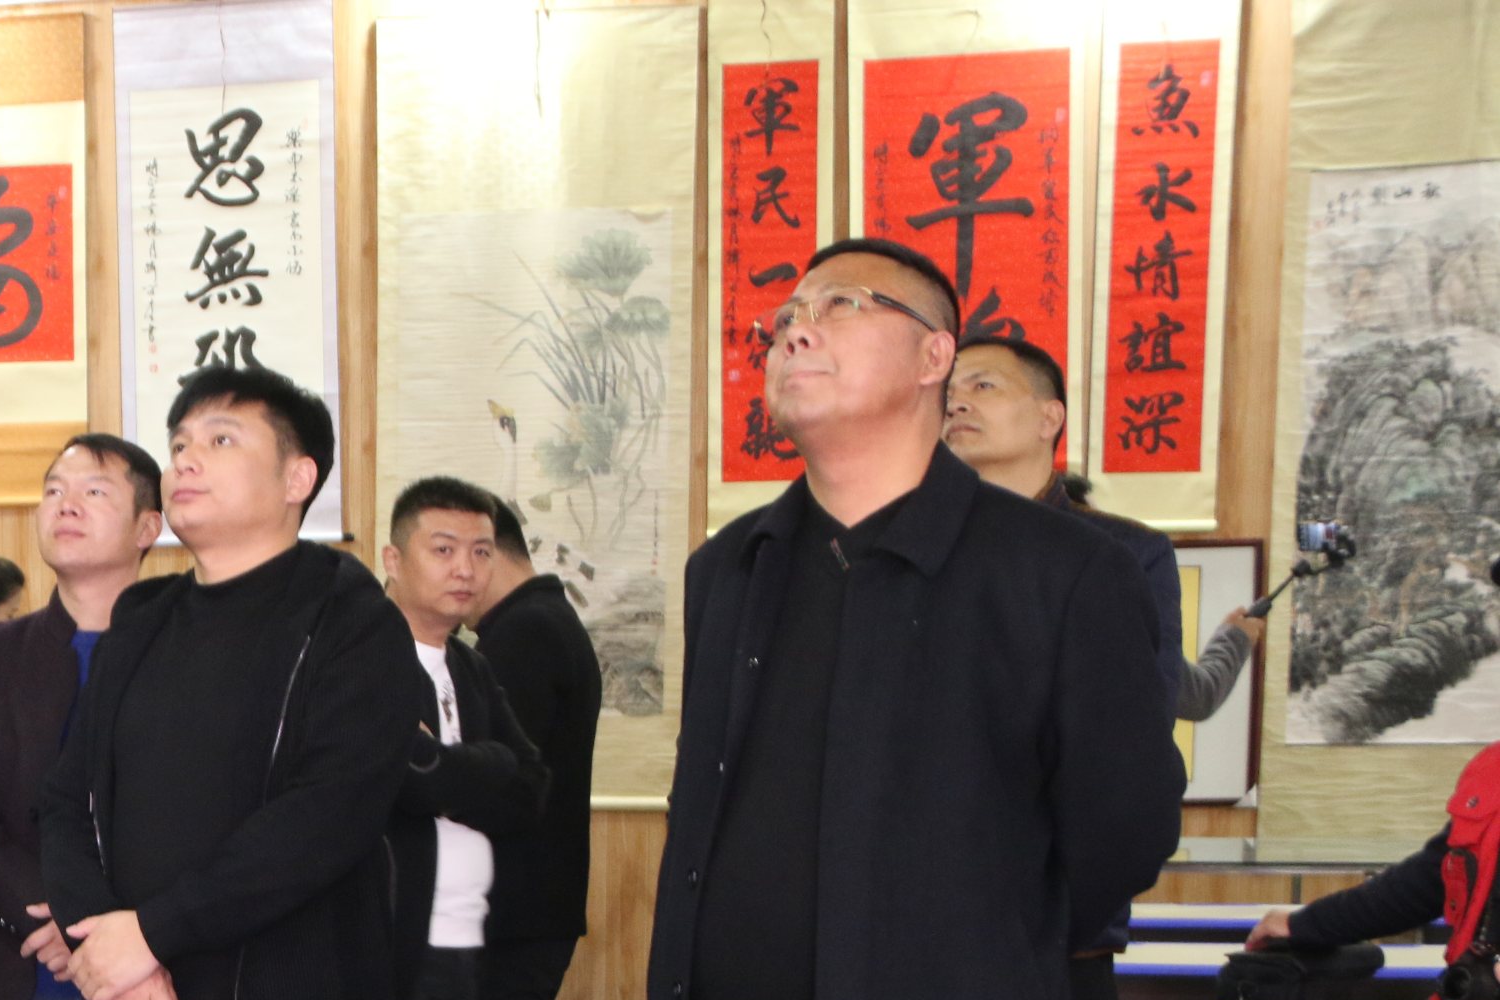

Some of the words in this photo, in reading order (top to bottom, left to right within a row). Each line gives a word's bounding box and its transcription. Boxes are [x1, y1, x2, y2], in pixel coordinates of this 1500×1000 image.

[1118, 64, 1200, 454] 魚水情誼深
